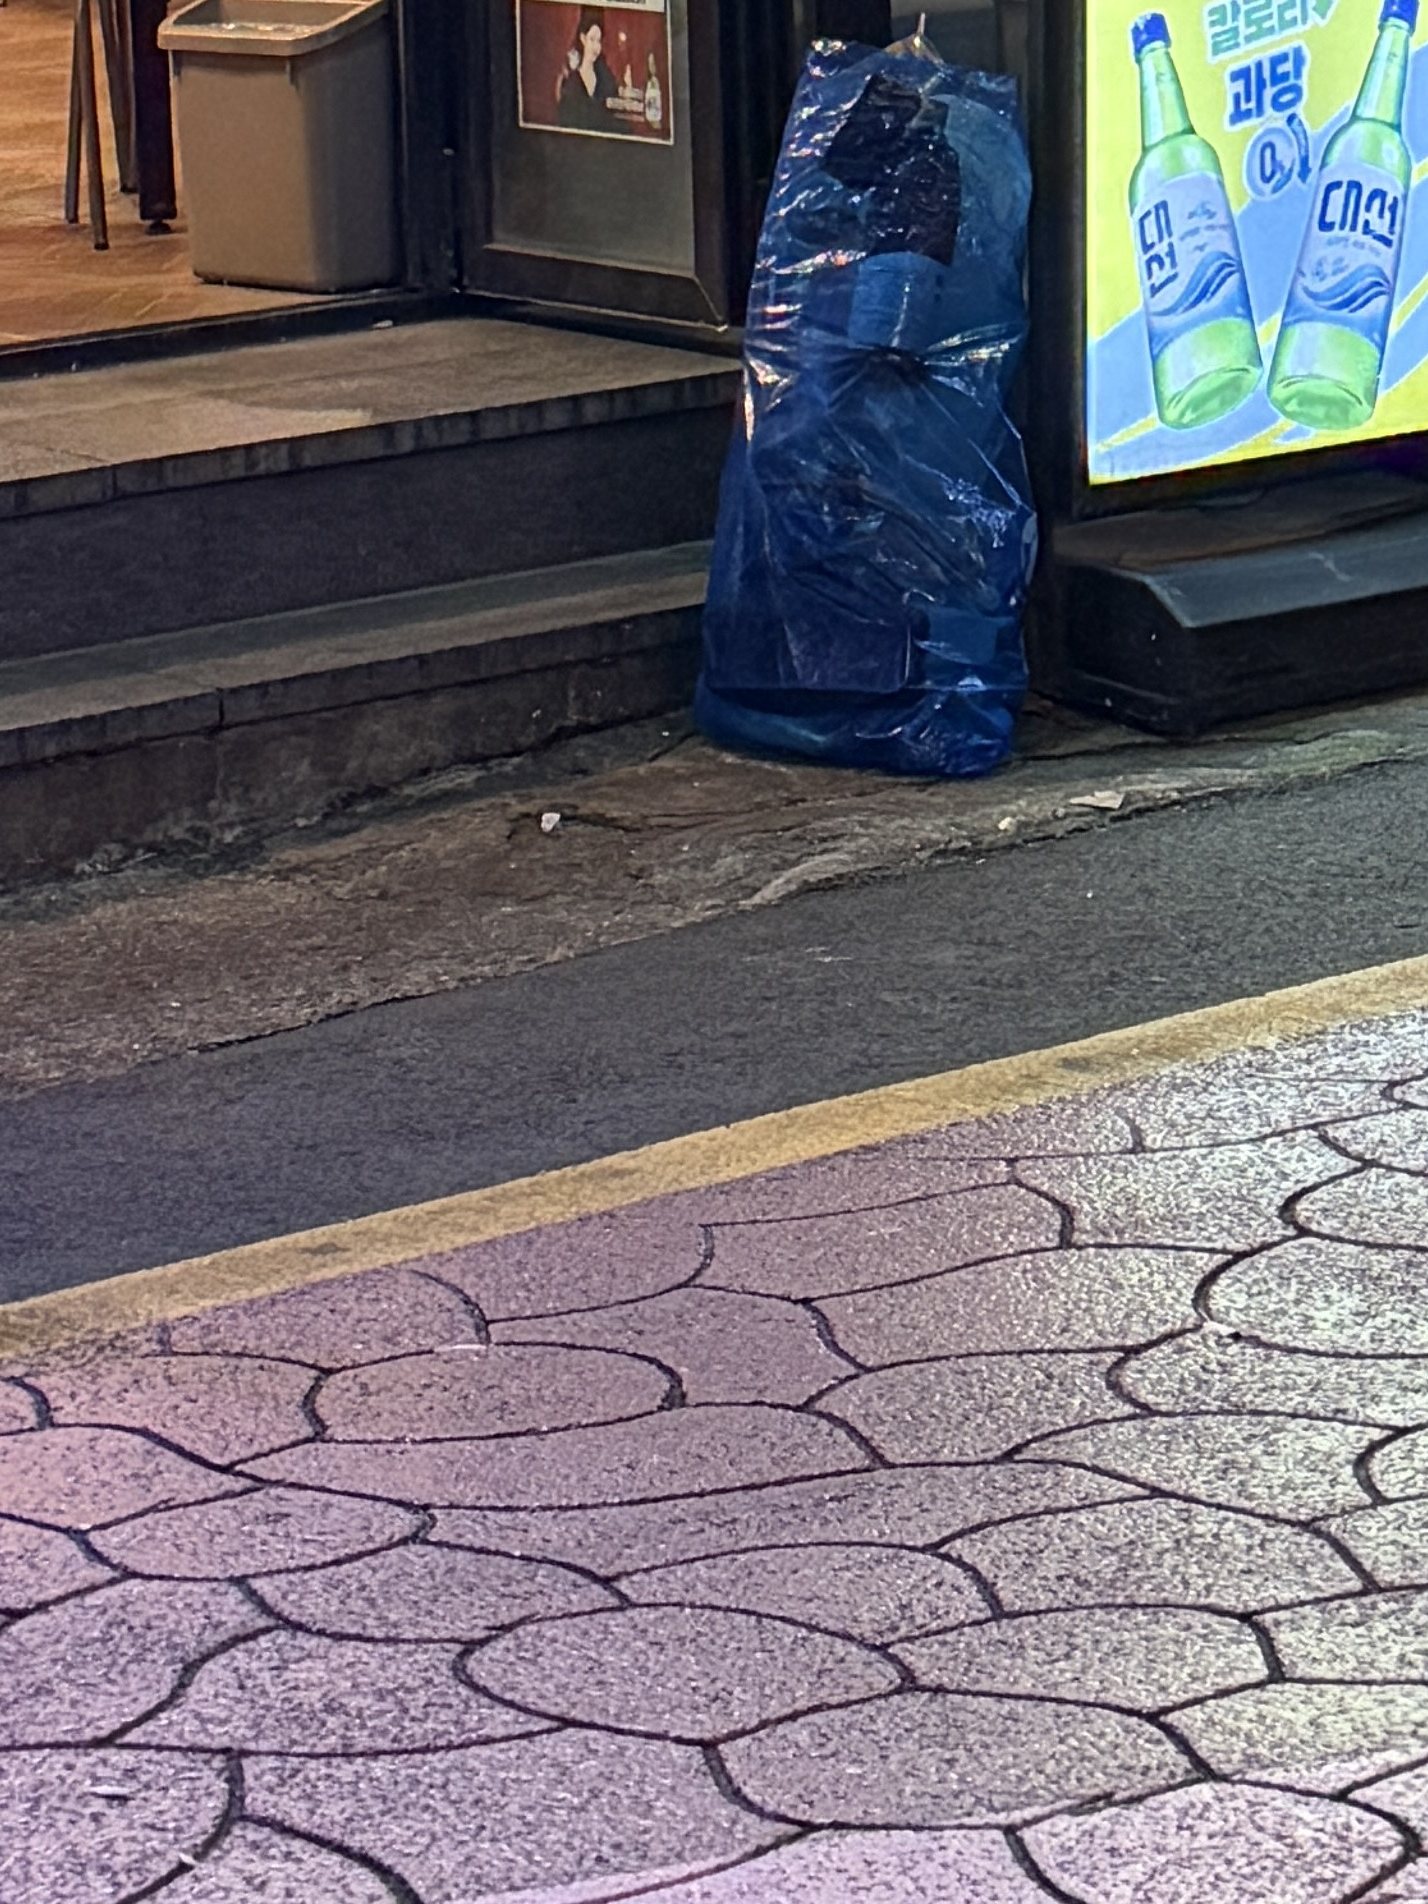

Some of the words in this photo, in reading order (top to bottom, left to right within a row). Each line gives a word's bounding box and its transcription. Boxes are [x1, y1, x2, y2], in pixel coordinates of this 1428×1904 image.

[1228, 46, 1306, 125] 과당
[1138, 198, 1180, 300] 대선
[1317, 179, 1399, 248] 대선
